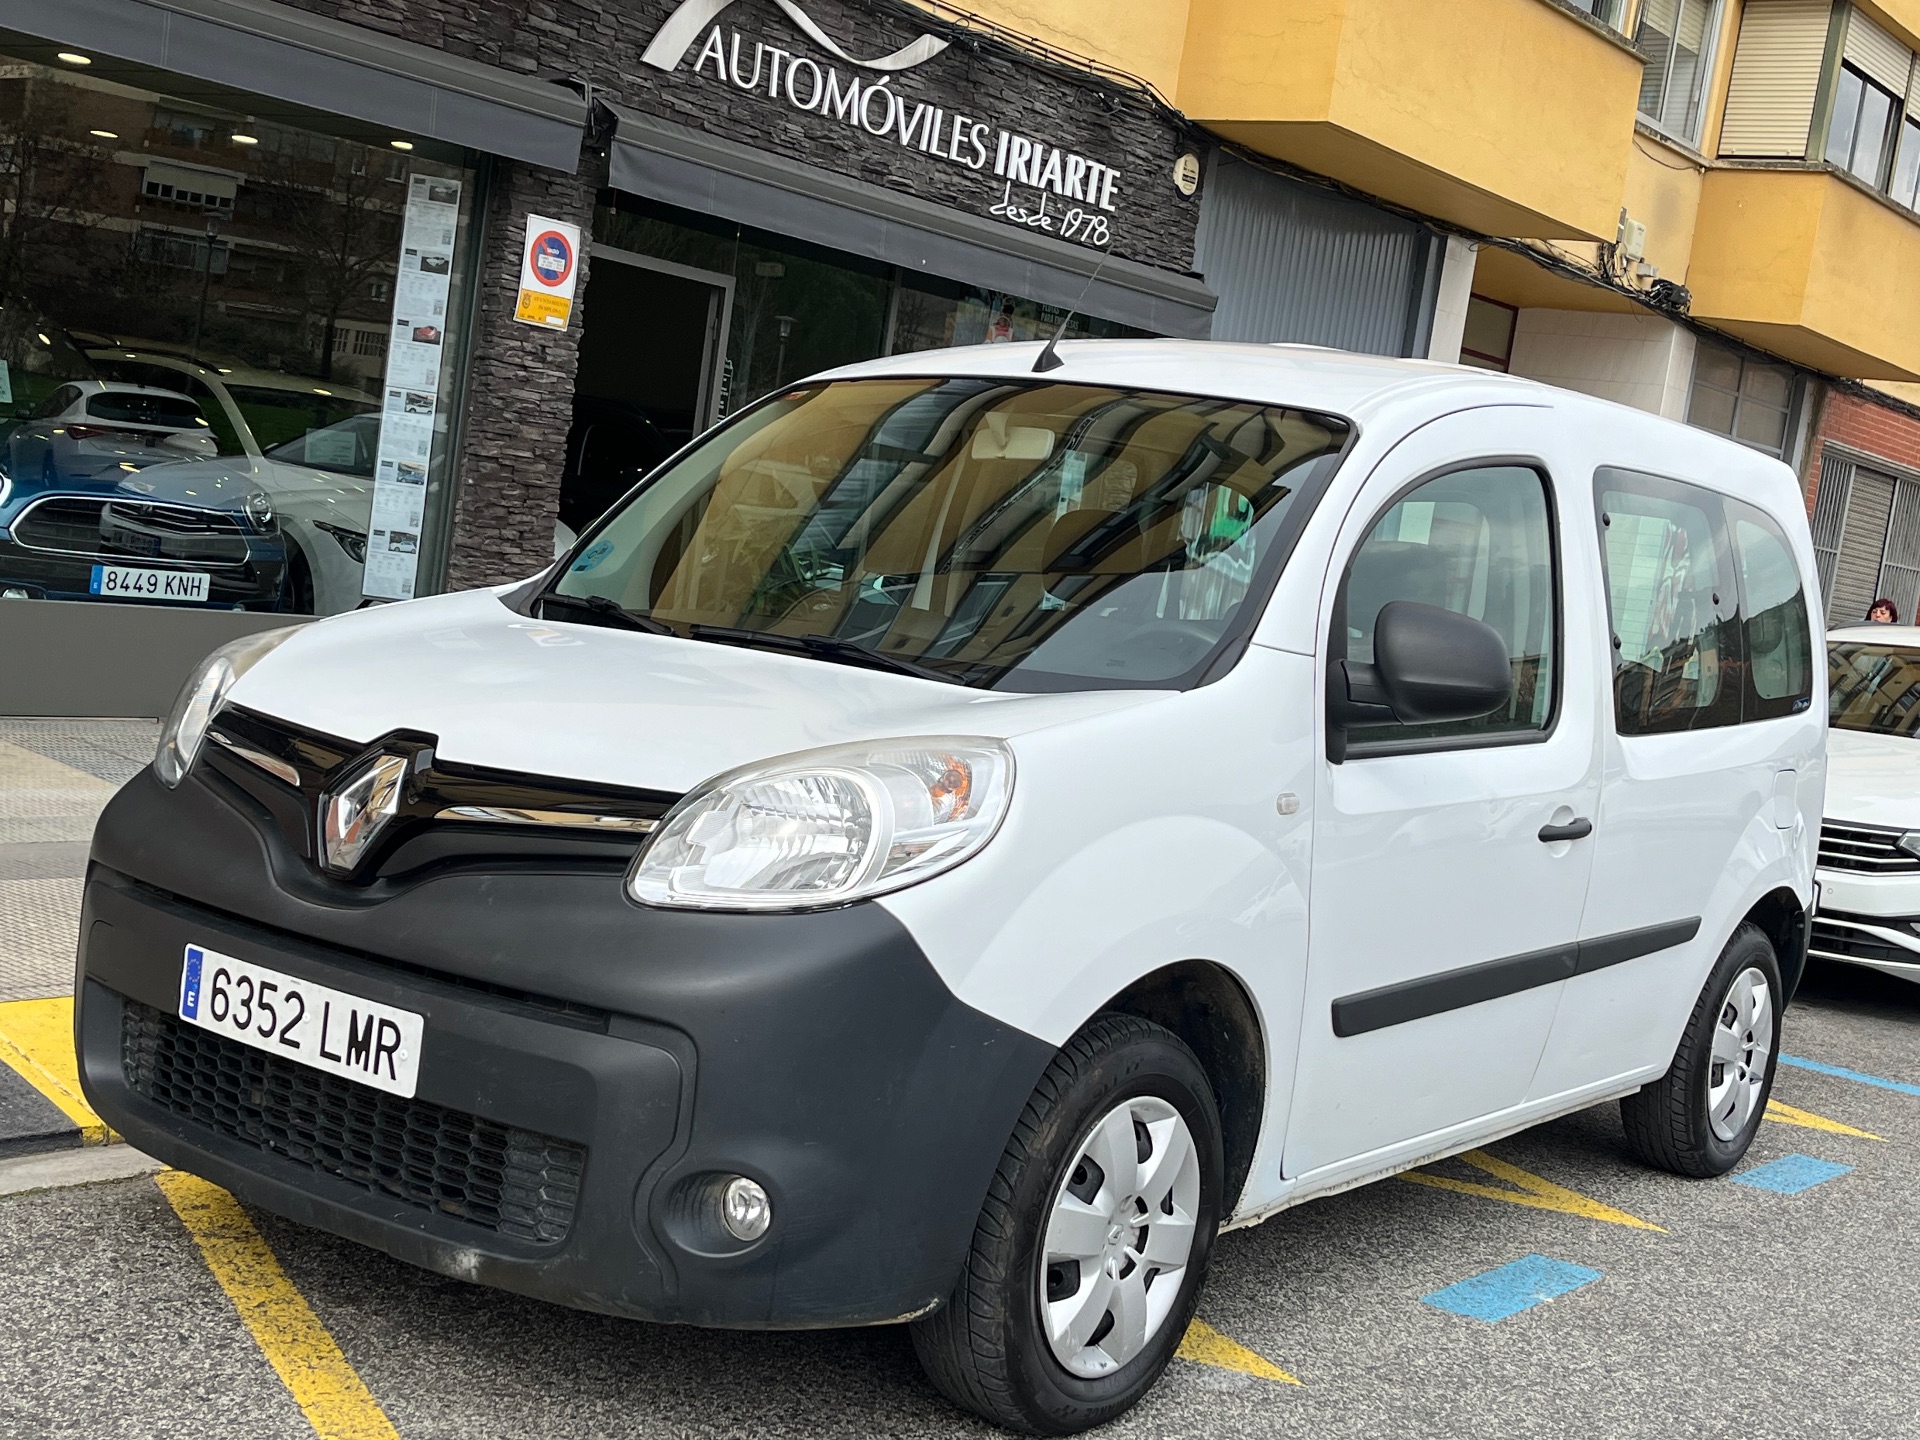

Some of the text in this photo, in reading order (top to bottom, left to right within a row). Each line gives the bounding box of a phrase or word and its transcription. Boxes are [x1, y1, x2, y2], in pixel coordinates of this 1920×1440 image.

[692, 24, 1121, 212] AUTOMÓVILES IRIARTE
[989, 180, 1110, 245] desde 1978
[106, 571, 202, 597] 8449 KNH
[187, 991, 196, 1007] E
[210, 967, 402, 1081] 6352 LMR
